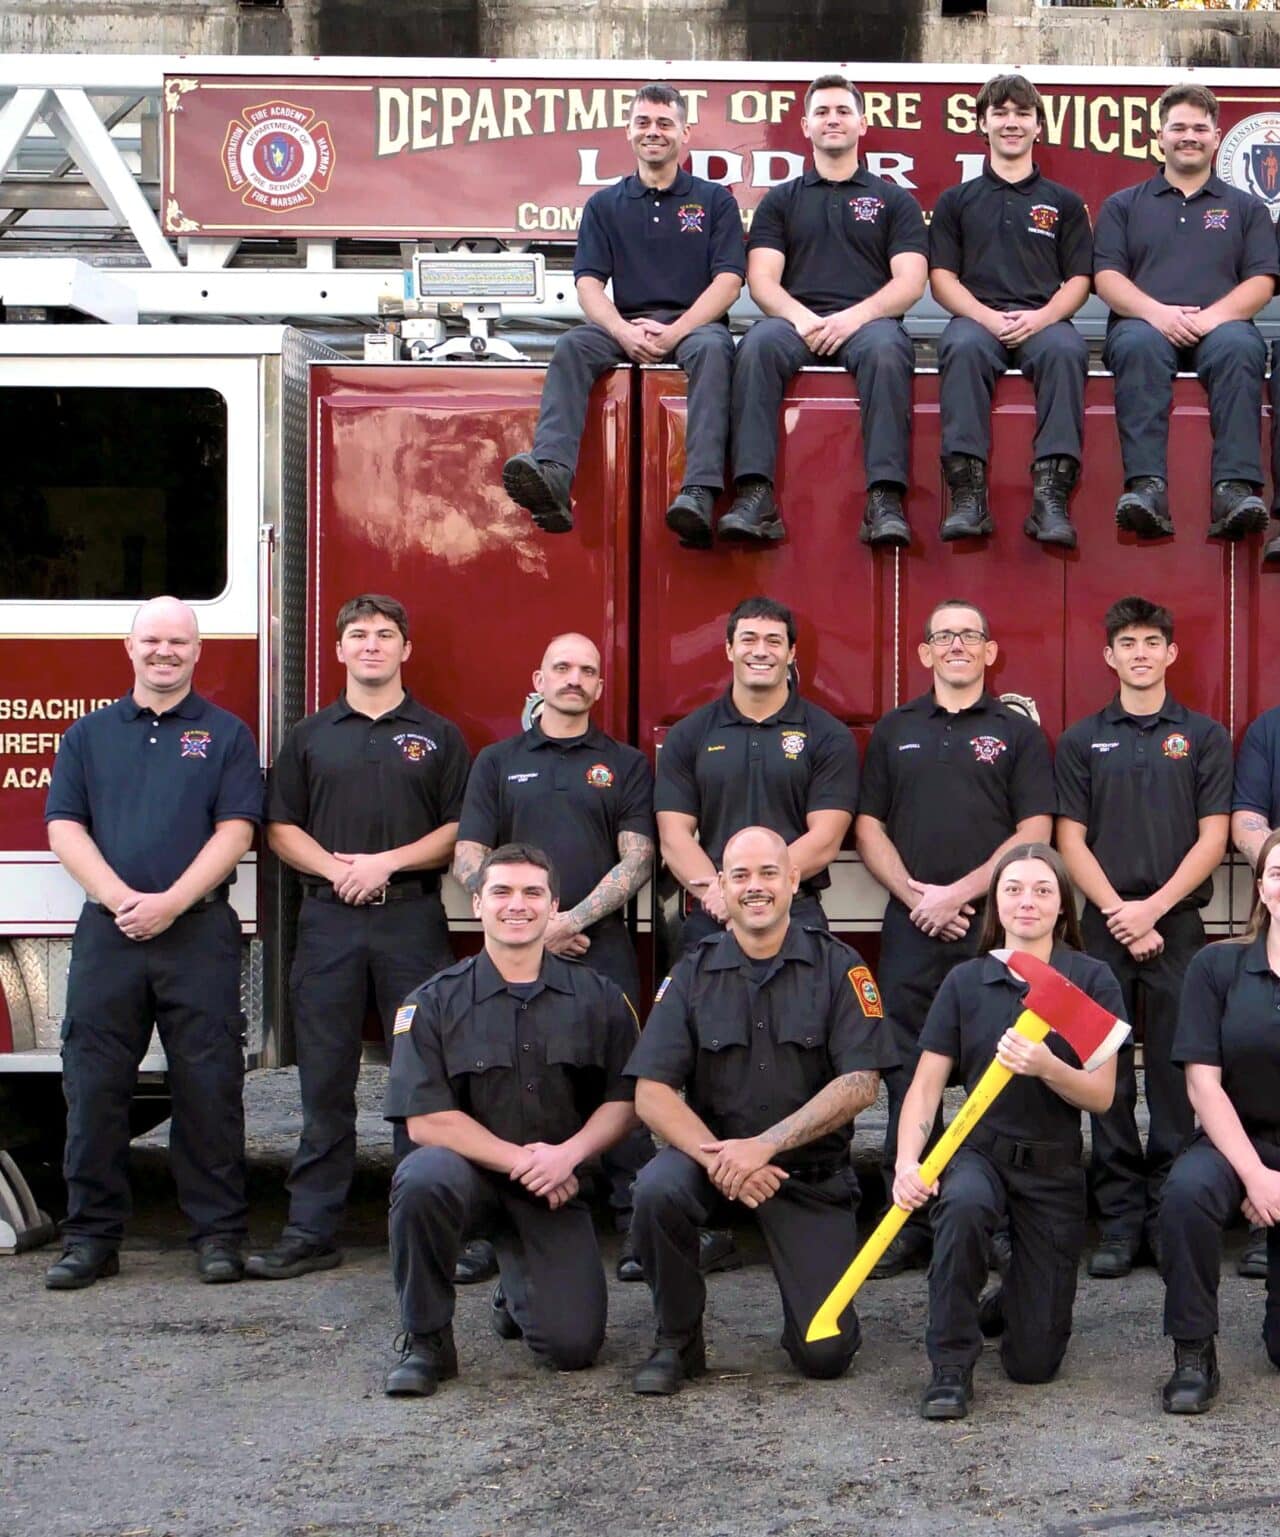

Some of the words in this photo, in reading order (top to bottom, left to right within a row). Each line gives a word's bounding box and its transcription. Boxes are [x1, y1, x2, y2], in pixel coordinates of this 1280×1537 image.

[251, 109, 268, 123] FIRE
[270, 106, 307, 123] ACADEMY
[377, 87, 709, 156] DEPARTMET
[730, 89, 796, 124] OF
[861, 91, 922, 130] RE
[947, 90, 1167, 164] SVICES
[246, 121, 299, 147] DEPARTMENT
[299, 134, 311, 146] OF
[227, 126, 245, 185] ADMINISTRATION
[316, 136, 330, 177] HAZMAT
[576, 148, 919, 189] LDDR
[249, 172, 265, 188] FIRE
[268, 173, 308, 192] SERVICES
[250, 191, 269, 204] FIRE
[270, 192, 308, 208] MARSHAL
[0, 698, 120, 720] SSACHU
